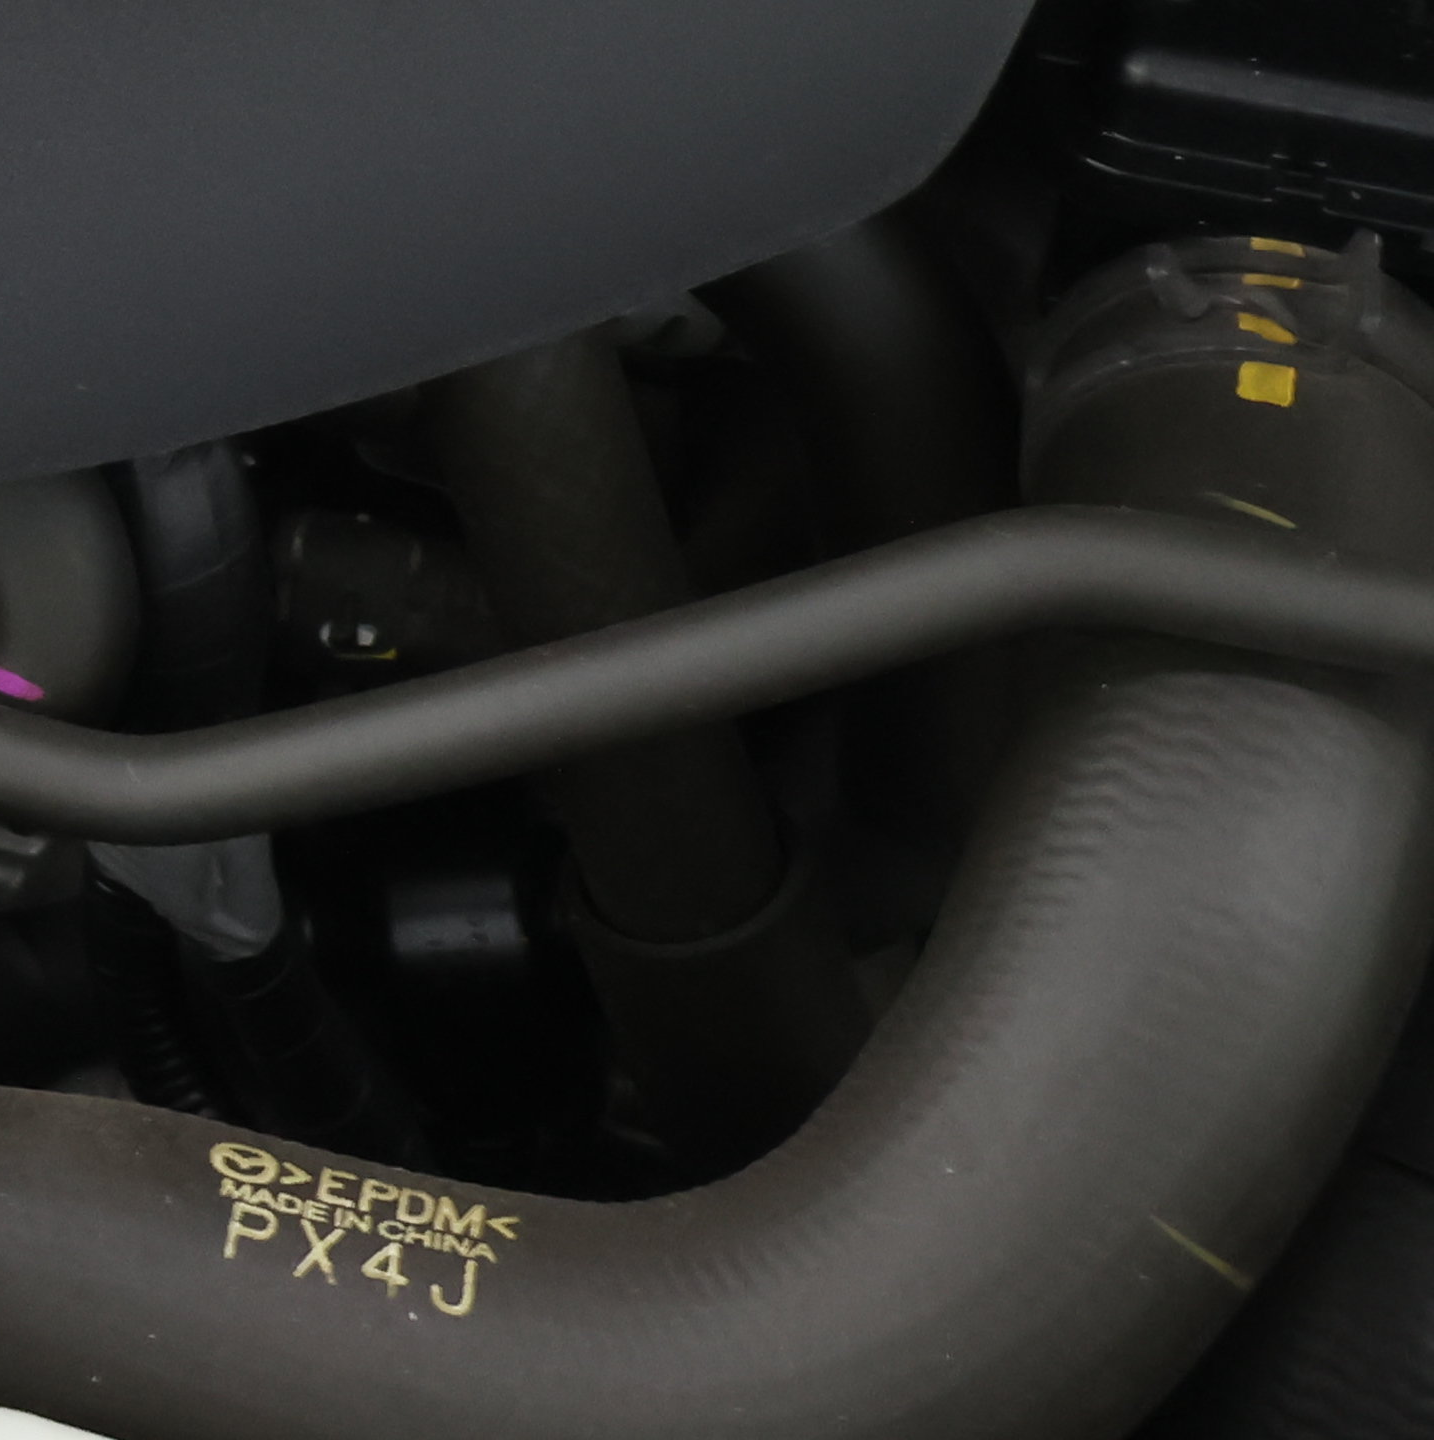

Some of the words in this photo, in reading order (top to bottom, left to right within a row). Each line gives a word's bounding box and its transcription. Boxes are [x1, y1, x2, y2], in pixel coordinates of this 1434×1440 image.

[220, 1177, 330, 1223] MADE
[334, 1207, 374, 1234] IN
[377, 1220, 499, 1263] CHINA
